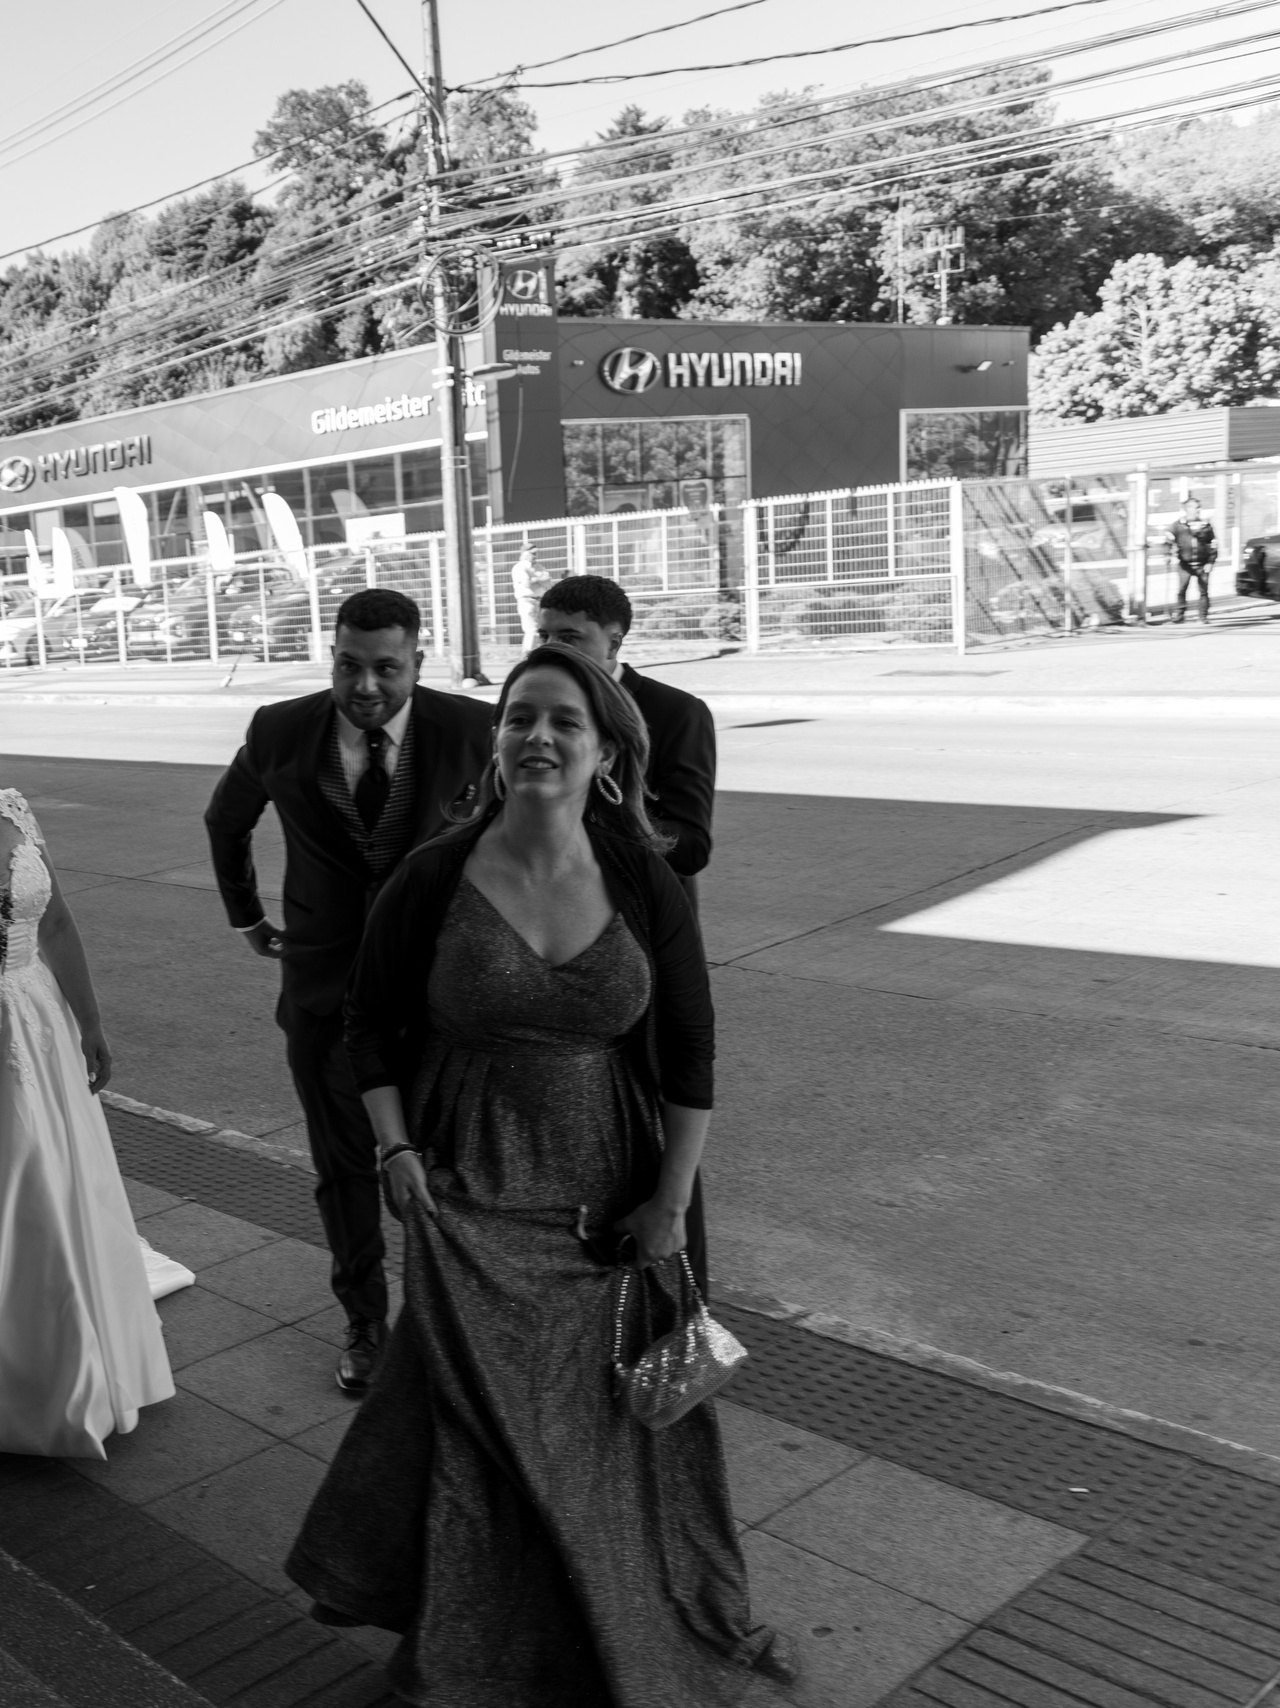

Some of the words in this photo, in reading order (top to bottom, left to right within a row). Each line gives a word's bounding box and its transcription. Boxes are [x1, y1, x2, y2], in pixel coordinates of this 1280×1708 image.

[668, 351, 802, 387] HYUNDAI
[311, 394, 433, 434] Gildemeister
[38, 434, 151, 482] HYUNDAI
